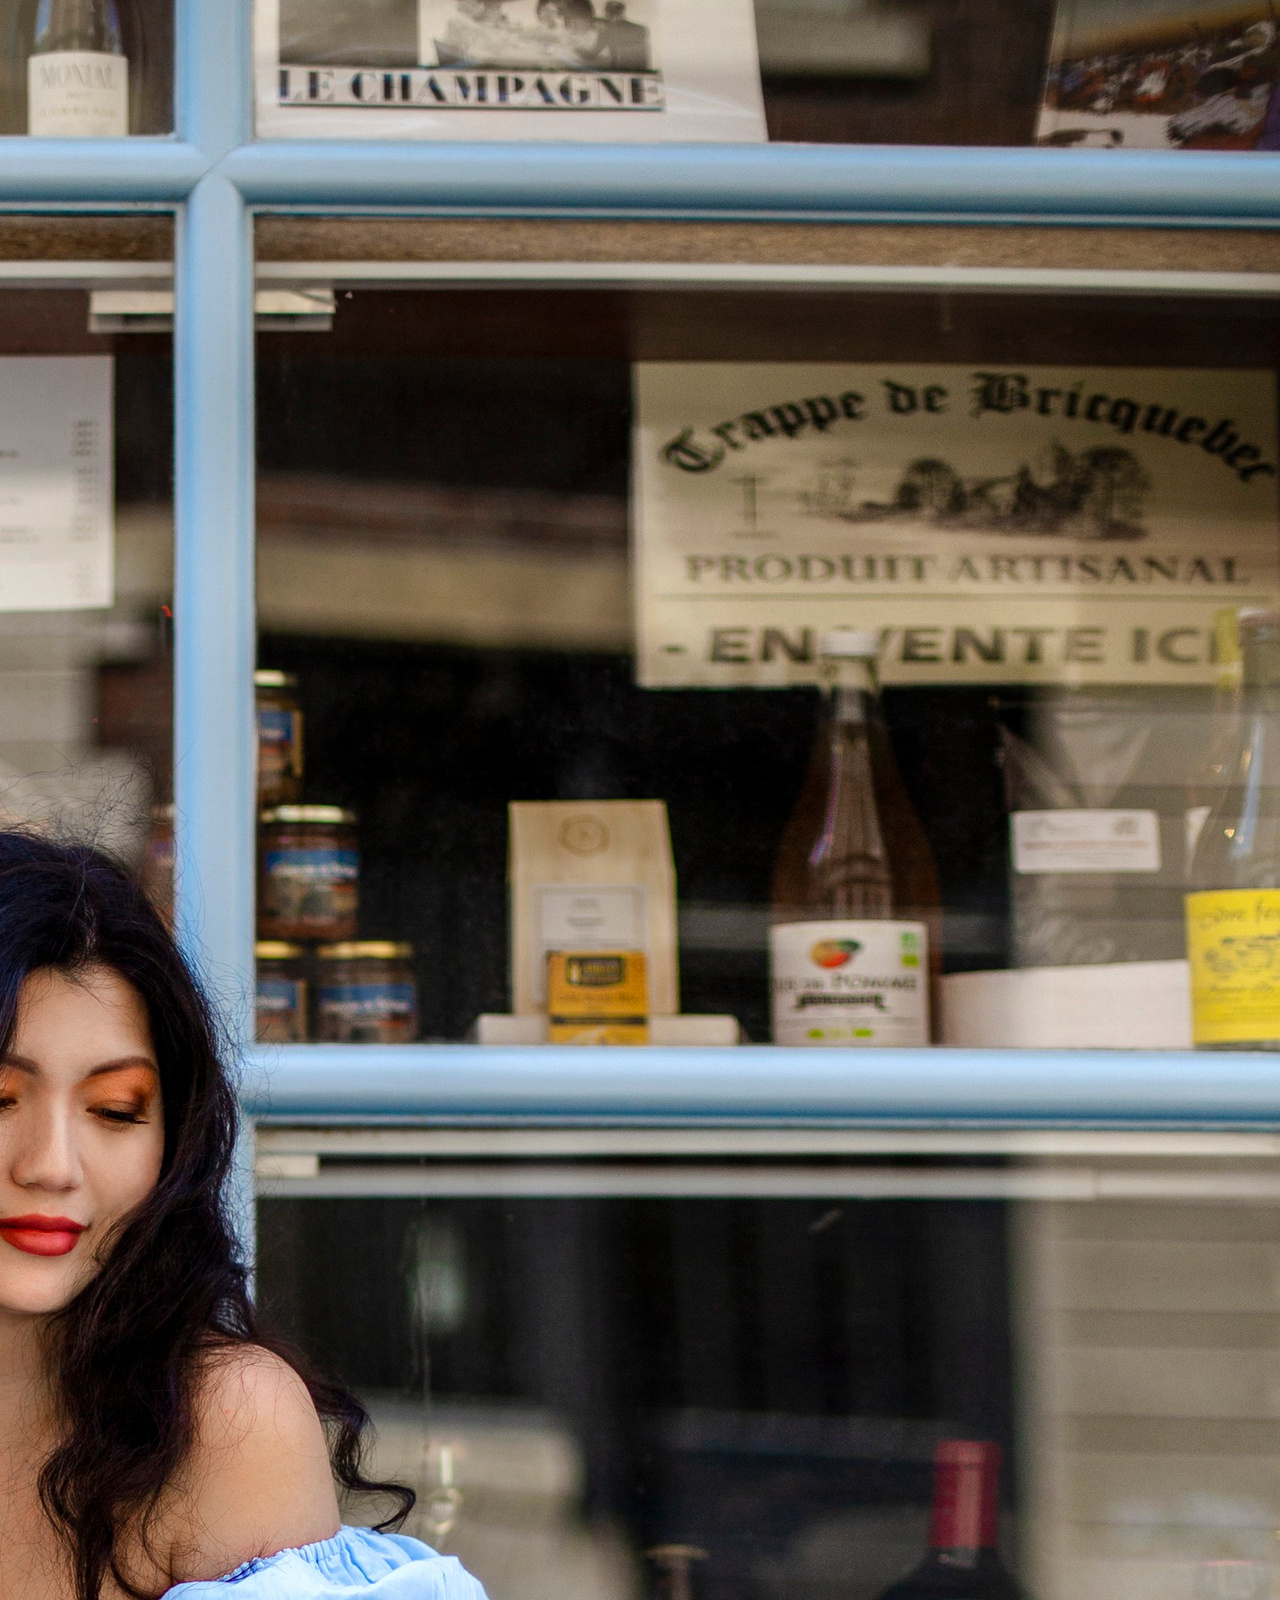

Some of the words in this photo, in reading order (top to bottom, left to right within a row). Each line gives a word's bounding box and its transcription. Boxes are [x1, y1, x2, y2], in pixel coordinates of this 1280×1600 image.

[278, 69, 333, 100] LE
[350, 70, 664, 106] CHAMPAGNE
[663, 389, 867, 474] Trappe
[881, 377, 948, 415] de
[683, 554, 934, 583] PRODUIT
[947, 554, 1250, 584] ARTISANAL
[708, 625, 812, 664] EN
